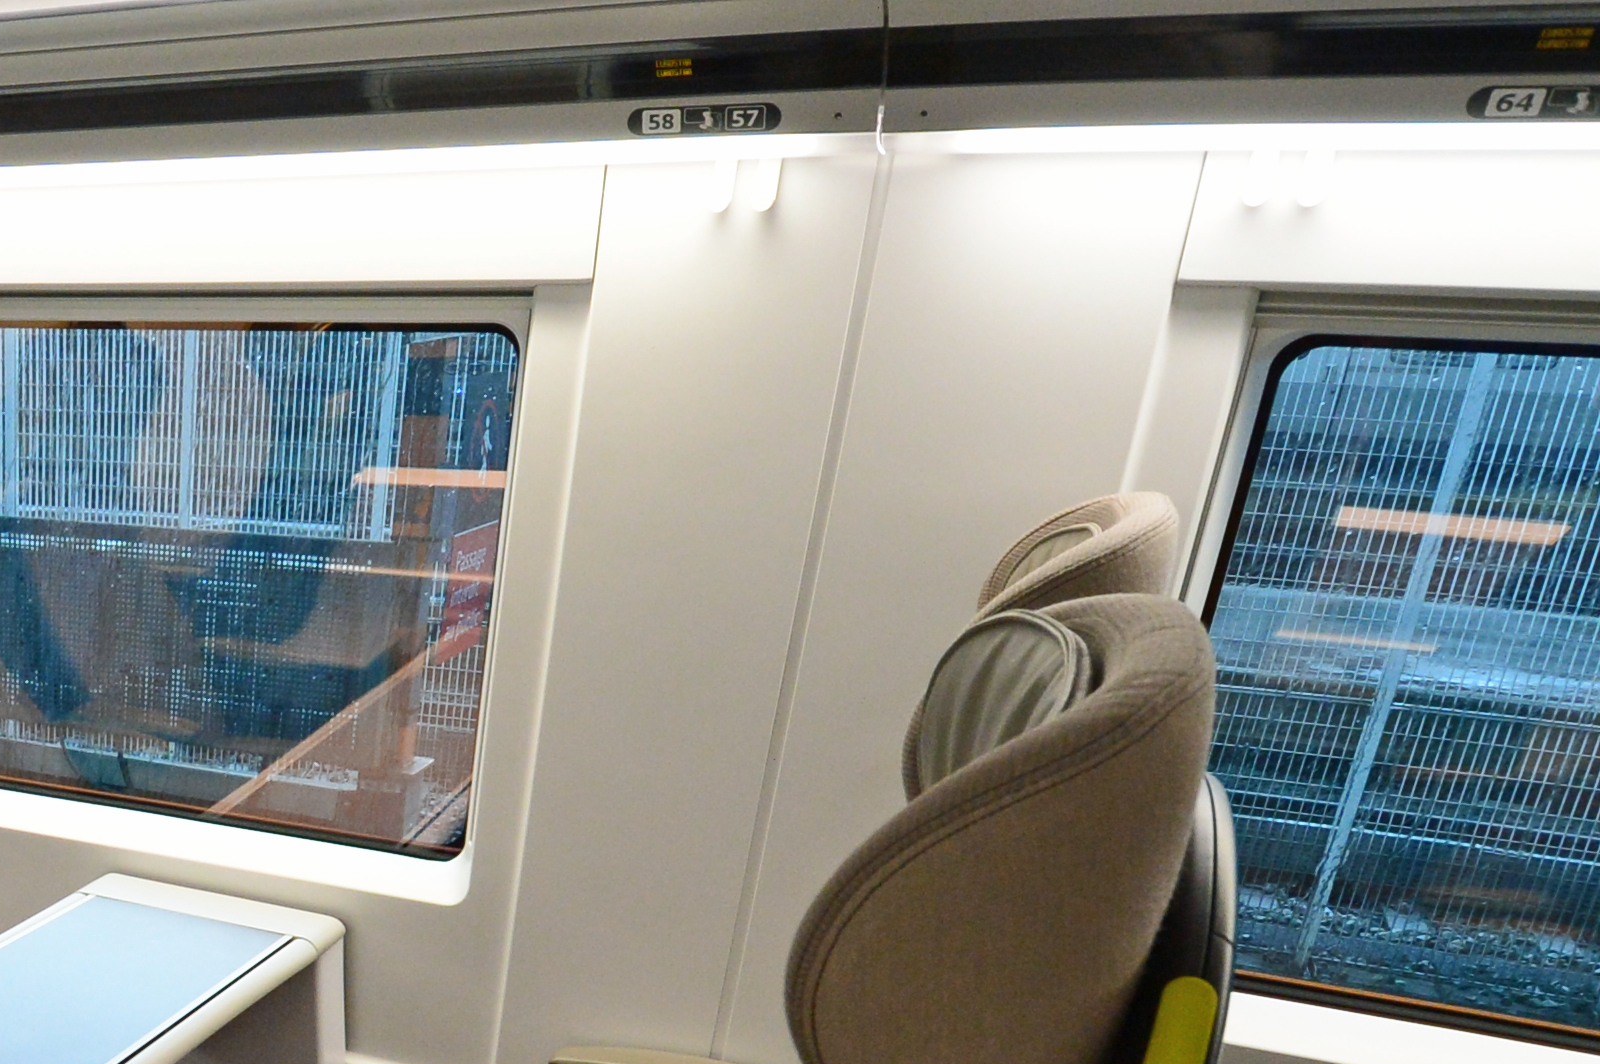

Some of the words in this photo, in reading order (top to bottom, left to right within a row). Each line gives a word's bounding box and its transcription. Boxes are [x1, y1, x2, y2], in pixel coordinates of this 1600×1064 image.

[1495, 92, 1535, 113] 64
[648, 113, 675, 130] 58
[731, 109, 760, 127] 57
[455, 547, 487, 573] Passage
